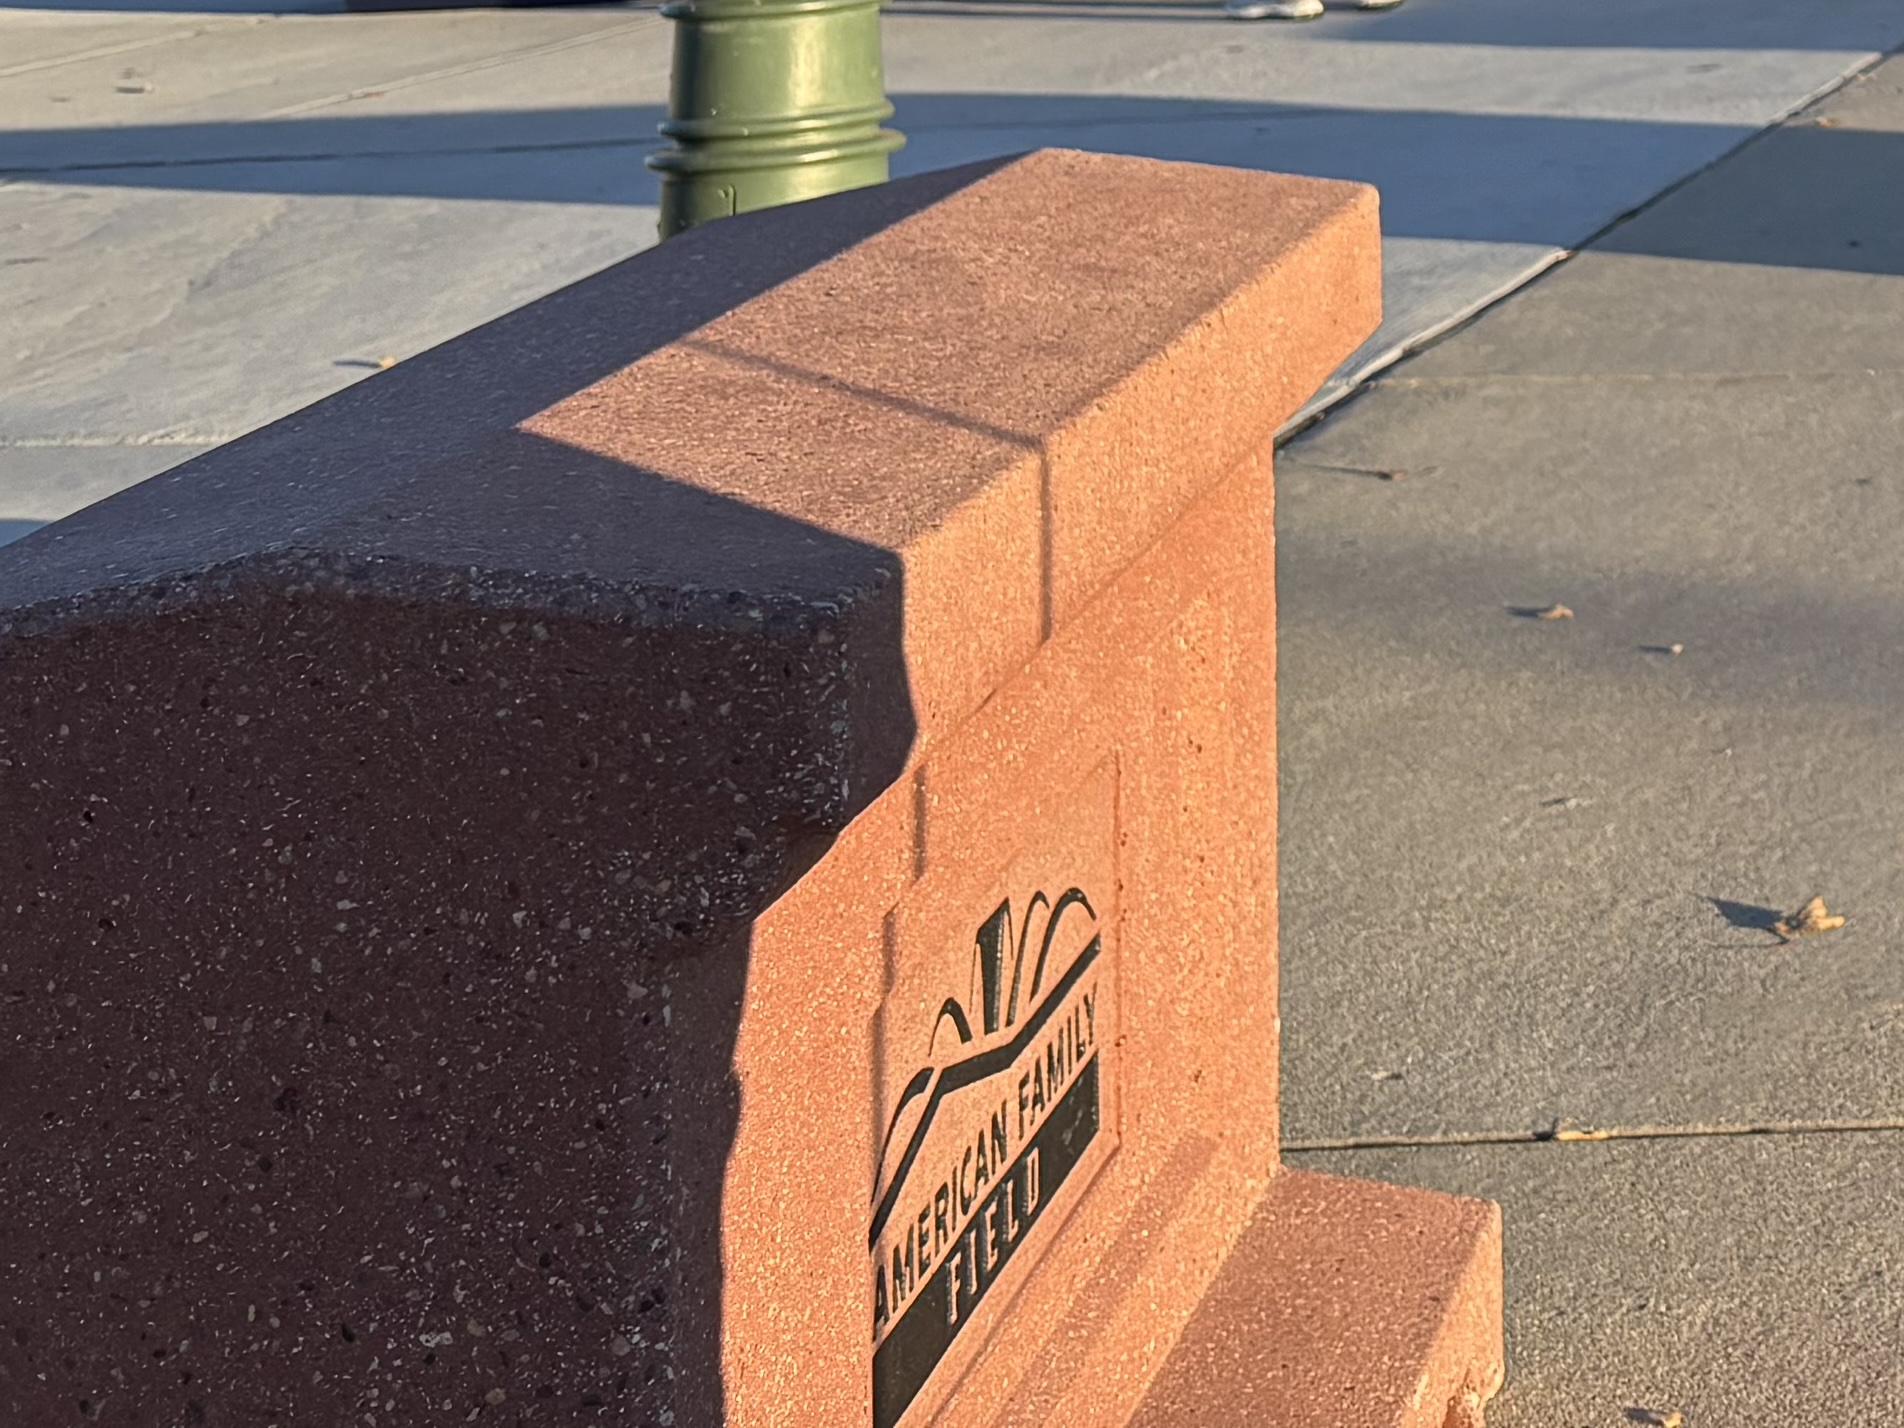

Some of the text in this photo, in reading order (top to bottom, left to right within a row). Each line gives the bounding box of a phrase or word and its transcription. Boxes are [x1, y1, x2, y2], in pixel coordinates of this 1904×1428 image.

[872, 979, 1100, 1332] AMERICAN FAMILY
[946, 1146, 1042, 1327] FIELD
